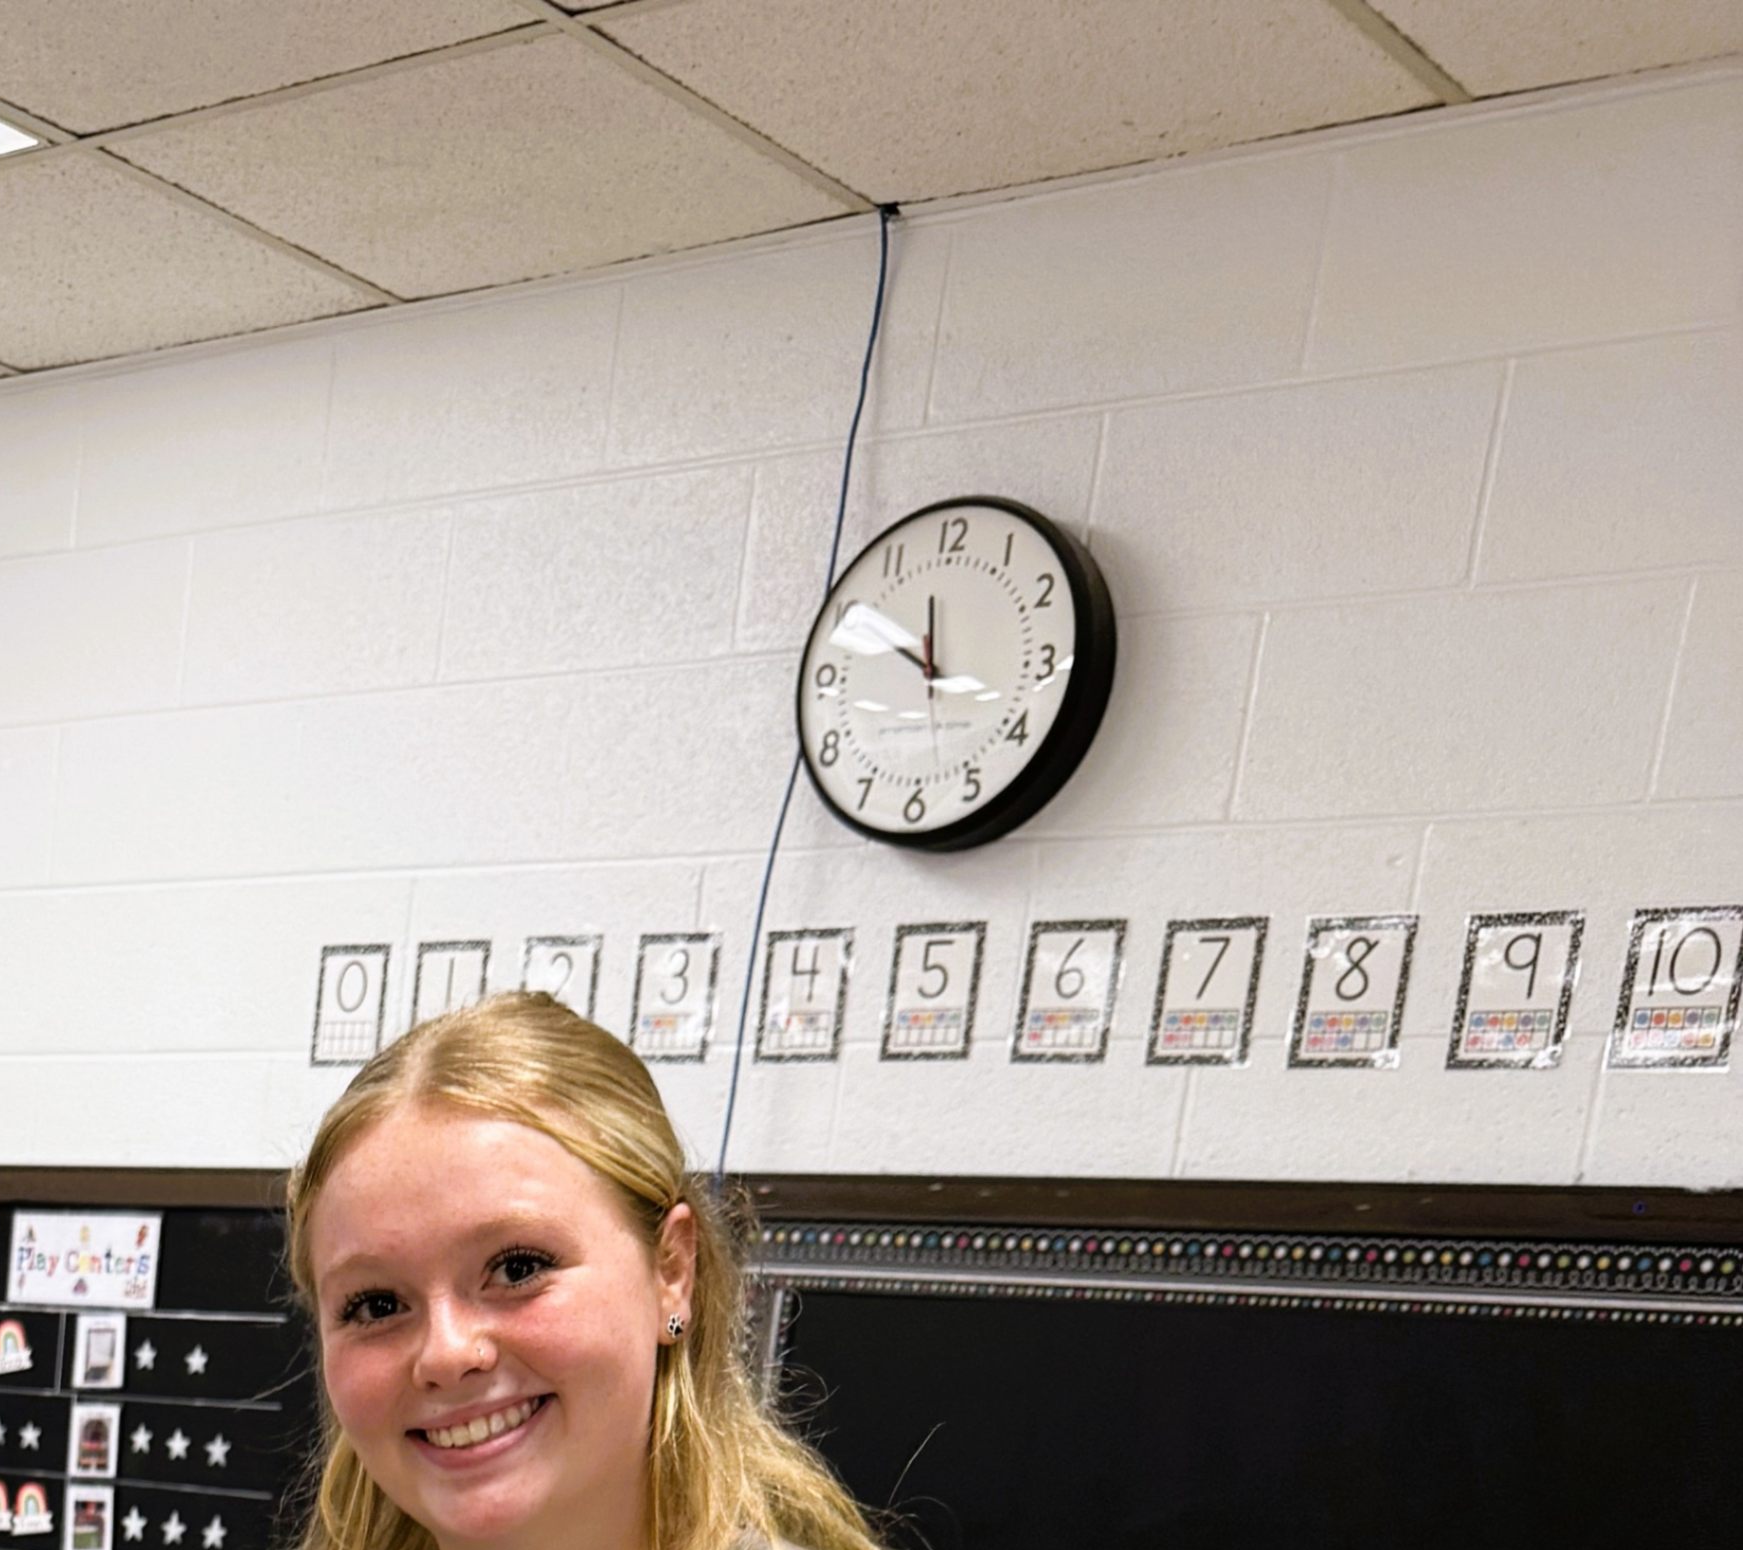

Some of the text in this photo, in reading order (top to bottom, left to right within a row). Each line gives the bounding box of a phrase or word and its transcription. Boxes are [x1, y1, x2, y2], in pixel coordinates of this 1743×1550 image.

[938, 518, 968, 554] 12
[1003, 532, 1014, 567] 1
[883, 543, 904, 579] 11
[1033, 573, 1055, 609] 2
[1036, 643, 1056, 681] 3
[816, 663, 836, 700] 9
[1005, 709, 1029, 747] 4
[819, 729, 840, 768] 8
[857, 777, 873, 811] 7
[962, 768, 981, 803] 5
[903, 788, 926, 823] 6
[335, 960, 368, 1013] 0
[658, 947, 690, 1005] 3
[792, 943, 822, 1004] 4
[917, 939, 955, 1000] 5
[1054, 937, 1086, 1000] 6
[1194, 936, 1231, 1001] 7
[1334, 936, 1379, 1001] 8
[1503, 932, 1543, 1000] 9
[1647, 925, 1723, 997] 10
[17, 1246, 150, 1277] Play Centers
